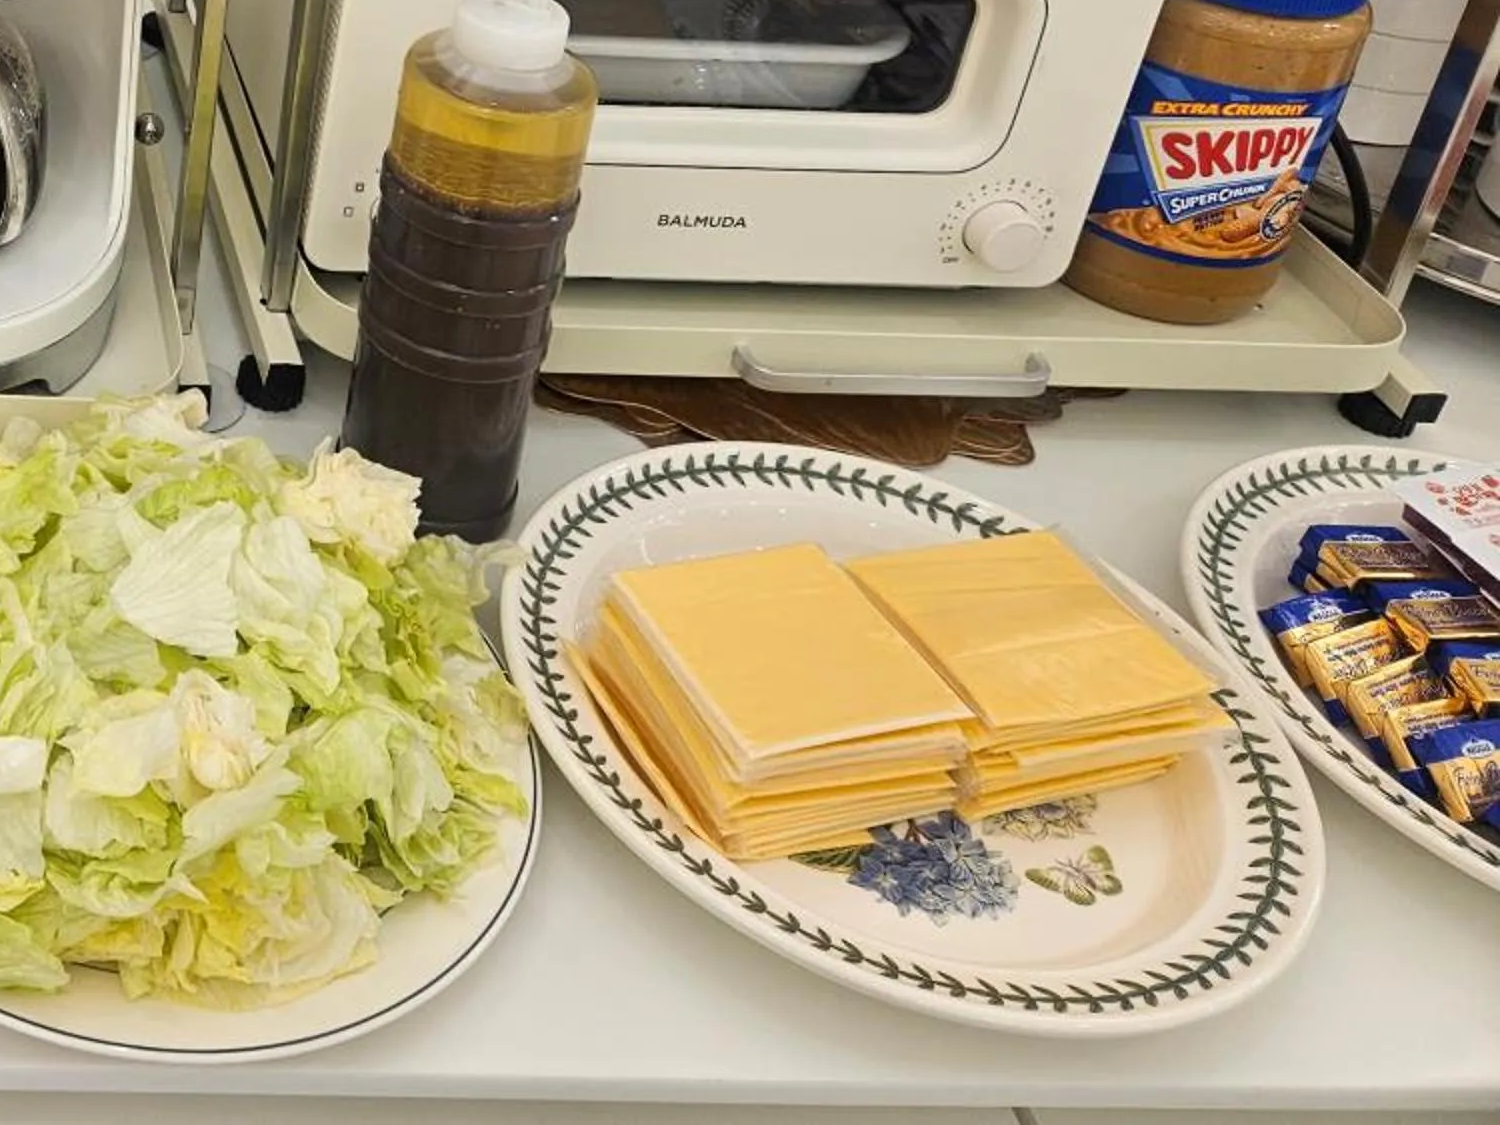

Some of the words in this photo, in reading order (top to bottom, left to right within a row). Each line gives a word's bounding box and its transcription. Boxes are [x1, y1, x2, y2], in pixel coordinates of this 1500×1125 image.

[1152, 101, 1220, 115] EXTRA
[1221, 102, 1309, 116] CRUNCHY
[1161, 126, 1315, 180] SKIPPY
[1169, 194, 1219, 215] SUPER
[657, 214, 747, 229] BALMUDA
